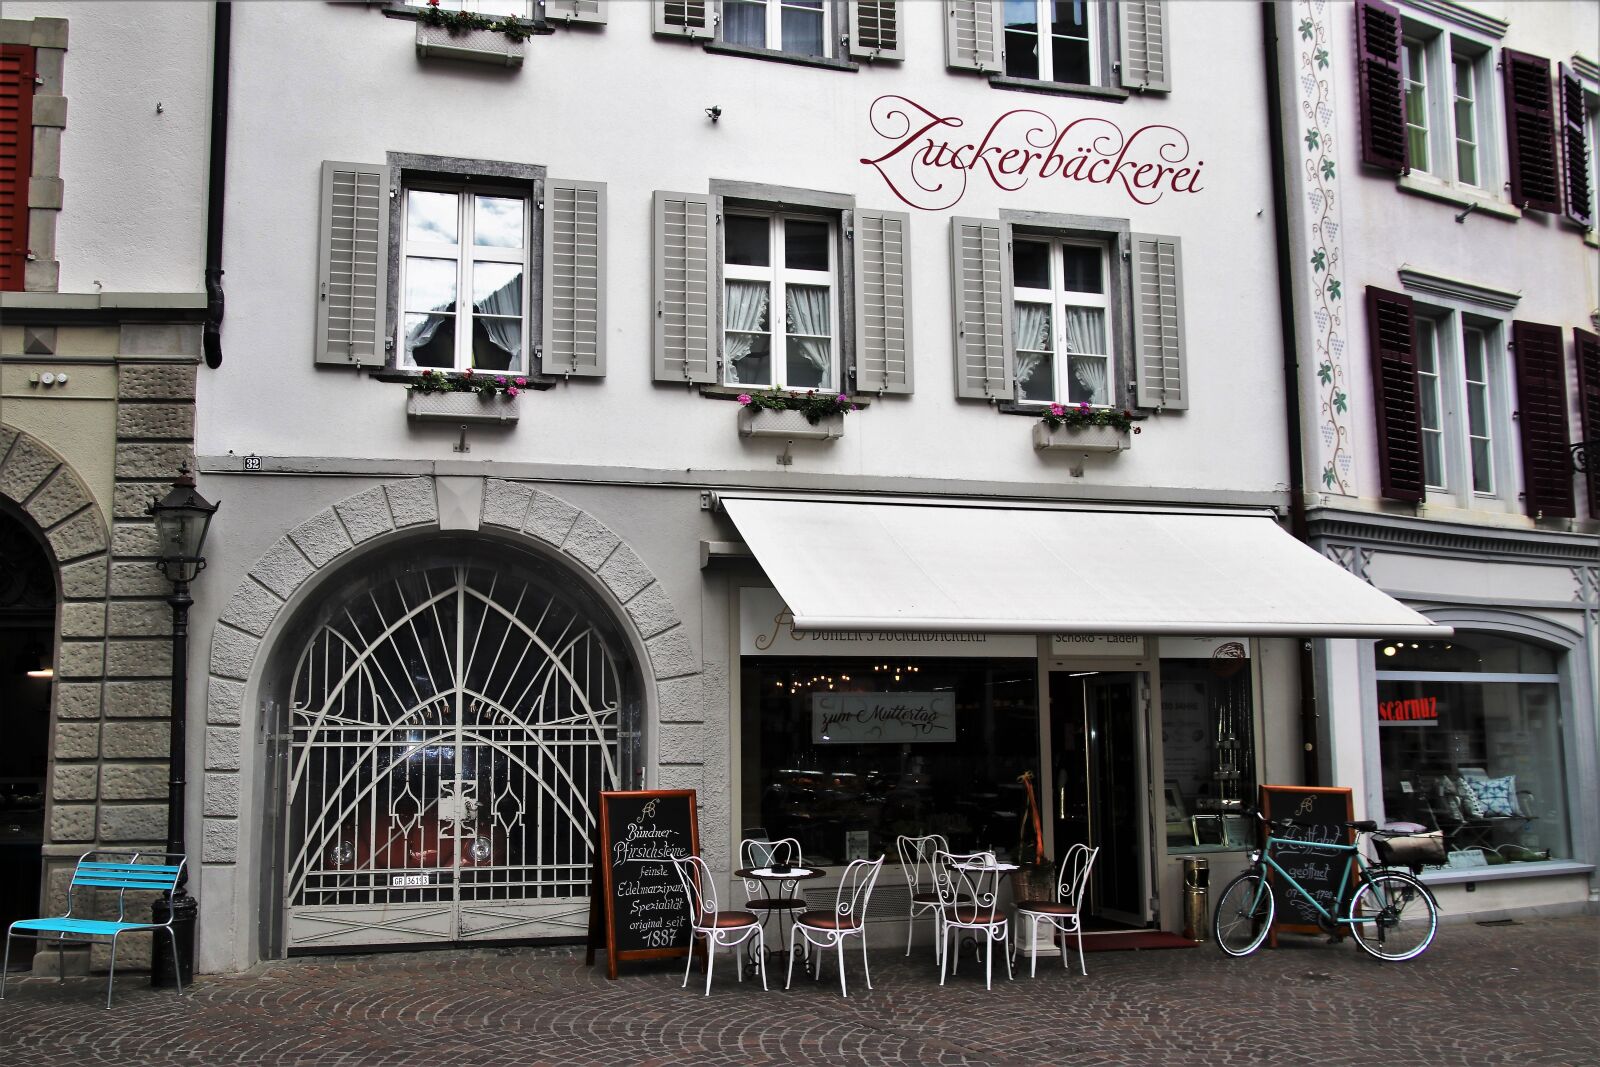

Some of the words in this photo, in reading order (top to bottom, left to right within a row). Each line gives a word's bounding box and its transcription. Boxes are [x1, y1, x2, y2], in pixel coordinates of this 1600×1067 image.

[860, 94, 1204, 211] Zuckerbäckerei
[246, 458, 260, 469] 32
[1379, 697, 1438, 721] scarnuz
[857, 705, 947, 734] Muttertag
[639, 864, 669, 879] feinste
[1289, 862, 1331, 880] geöffnet
[394, 877, 404, 886] GR
[617, 880, 684, 900] Edelmarzipan
[629, 898, 684, 916] Spezialität
[629, 917, 663, 932] original
[665, 916, 686, 927] seit
[642, 928, 677, 947] 1887
